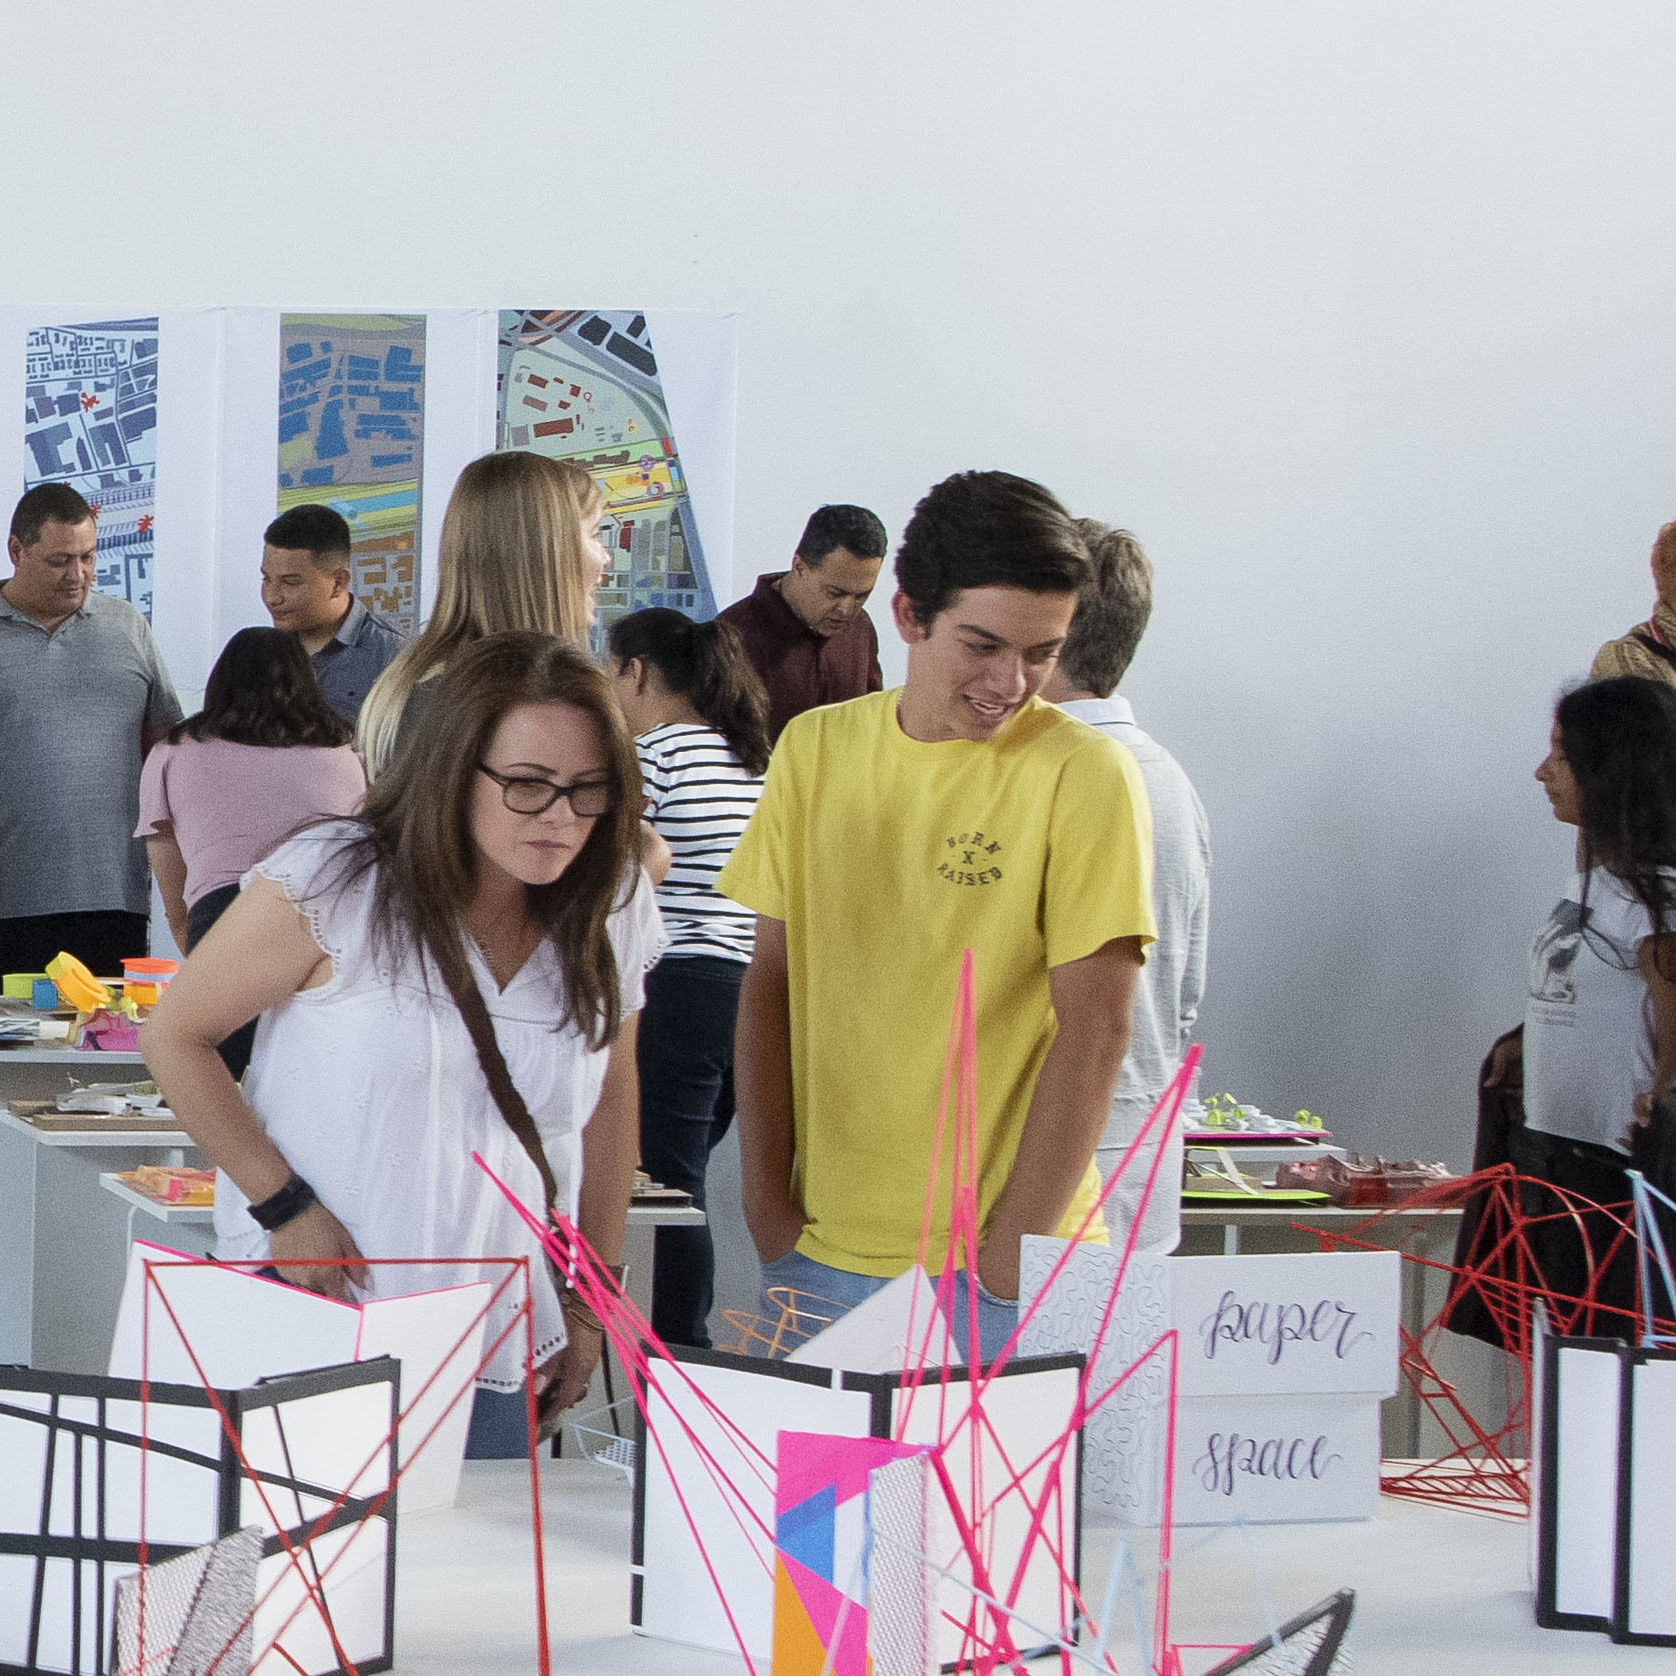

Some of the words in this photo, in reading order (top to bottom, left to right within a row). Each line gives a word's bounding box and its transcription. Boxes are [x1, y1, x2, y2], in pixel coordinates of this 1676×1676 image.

[946, 831, 1001, 855] BORN
[937, 862, 1002, 886] RAISED
[1198, 1289, 1377, 1366] paper
[1191, 1431, 1345, 1497] space
